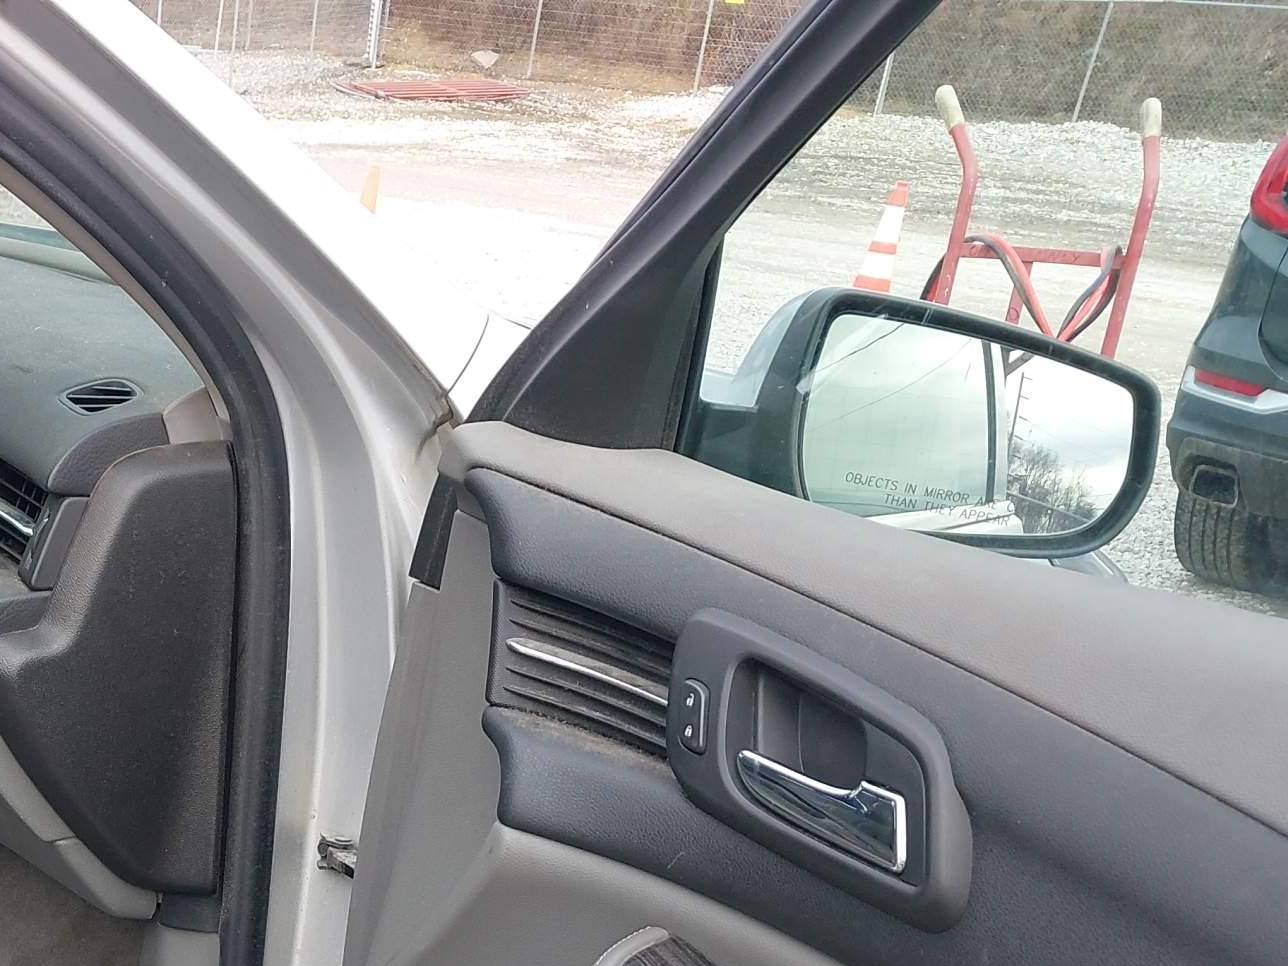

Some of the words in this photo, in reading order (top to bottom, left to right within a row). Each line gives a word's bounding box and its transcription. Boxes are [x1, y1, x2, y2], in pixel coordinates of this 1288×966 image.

[845, 471, 899, 491] OBJECTS
[904, 482, 918, 495] IN
[923, 486, 970, 504] MIRROR
[884, 493, 918, 509] THAN
[924, 501, 956, 517] THEY
[959, 508, 1011, 527] APPEAR
